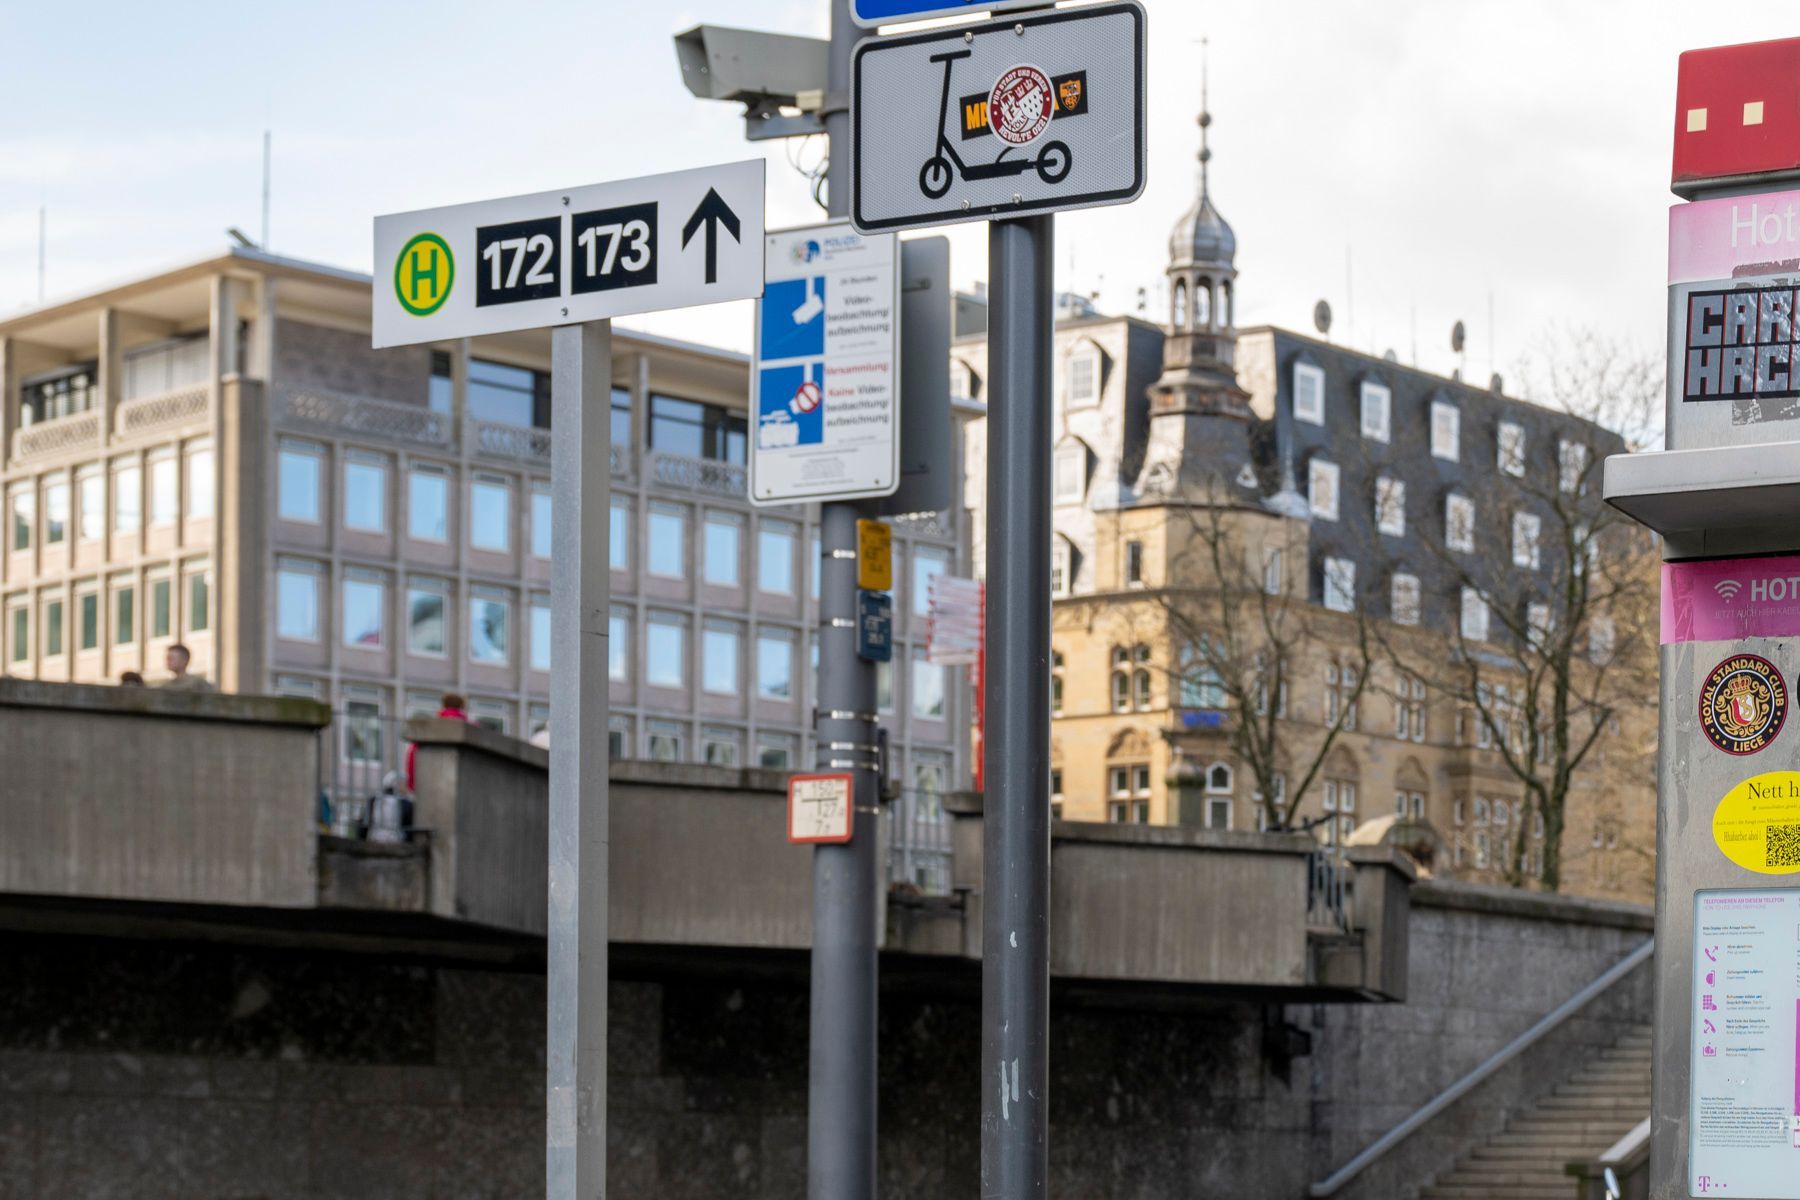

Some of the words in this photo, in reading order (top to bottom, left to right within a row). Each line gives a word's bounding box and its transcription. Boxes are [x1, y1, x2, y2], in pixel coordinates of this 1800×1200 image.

[411, 248, 438, 300] H
[483, 234, 554, 290] 172
[578, 219, 651, 276] 173
[1702, 685, 1717, 726] ROYAL
[1712, 659, 1770, 684] STANDARD
[1769, 675, 1785, 707] CLUB
[1733, 735, 1766, 752] LIEGE
[1748, 782, 1784, 800] Nett
